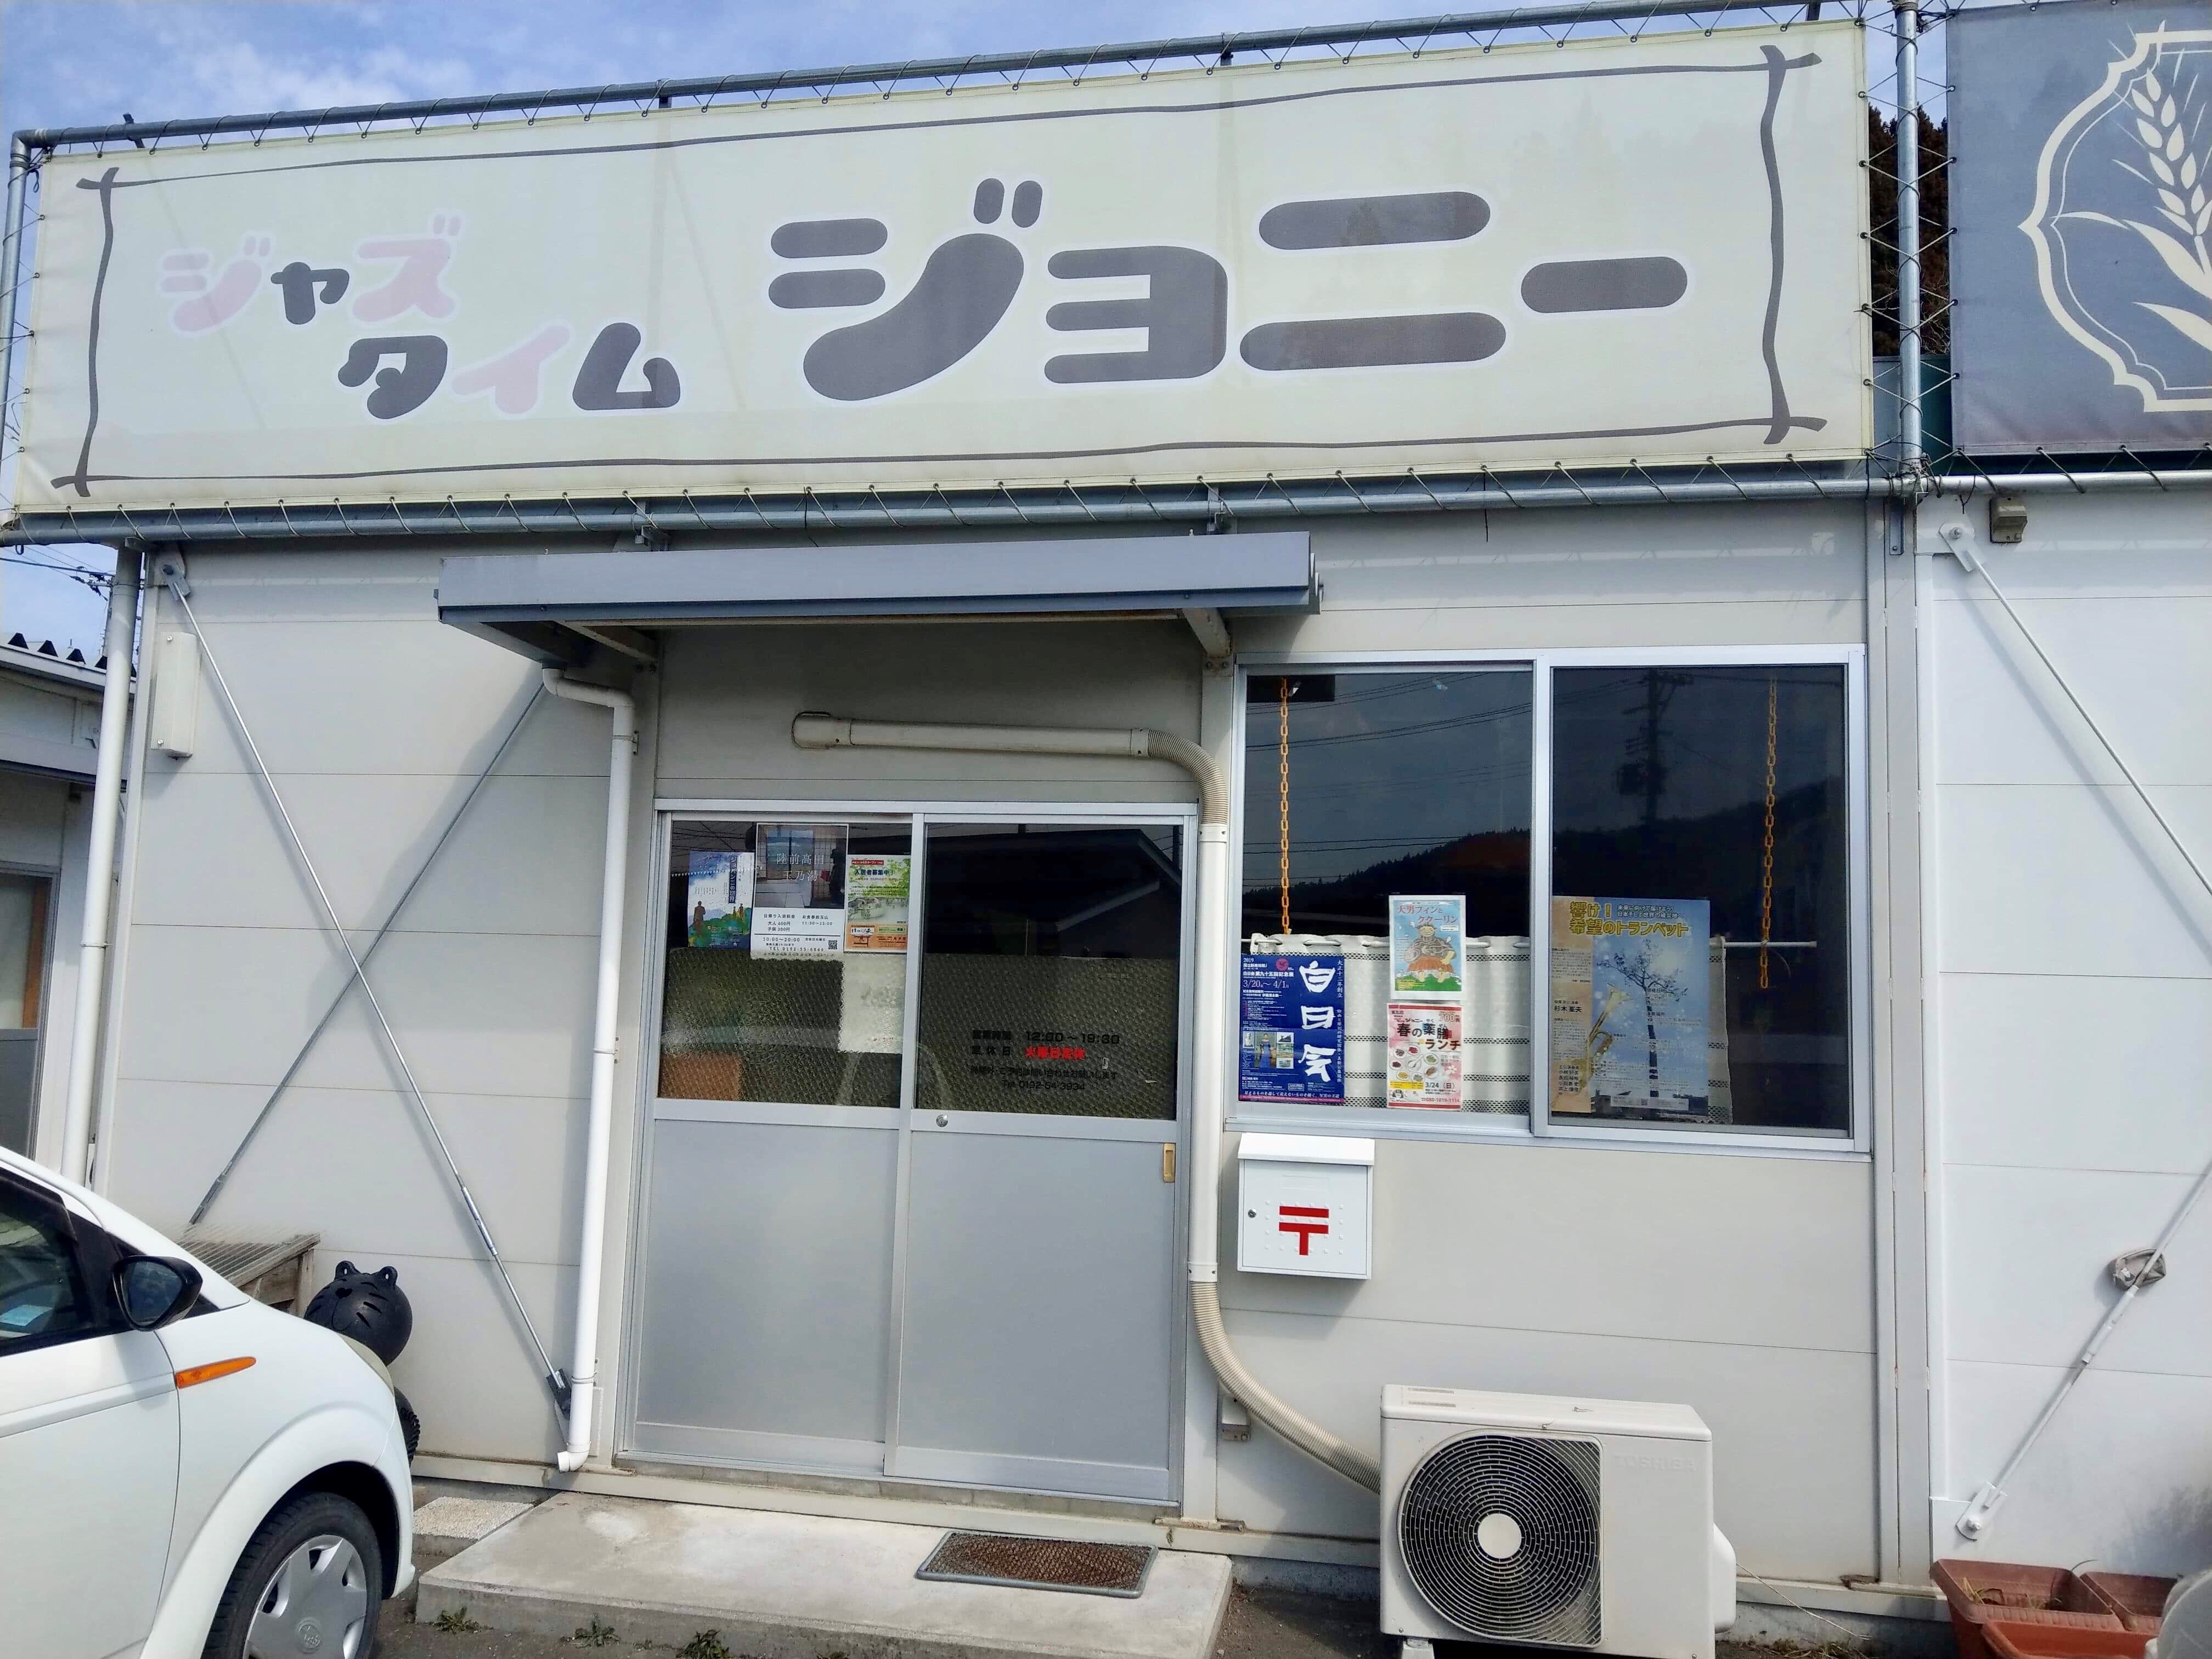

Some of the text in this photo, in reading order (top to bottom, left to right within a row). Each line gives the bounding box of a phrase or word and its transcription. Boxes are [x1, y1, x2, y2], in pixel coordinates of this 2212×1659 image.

[160, 215, 455, 331] ジャズ
[768, 178, 1688, 401] ジョニー
[337, 323, 681, 420] タイム
[1569, 918, 1690, 938] 希望のトランペット
[1570, 901, 1612, 918] 響け！
[1297, 960, 1336, 1082] 白日会
[1425, 1039, 1461, 1051] ランチ
[1614, 1454, 1697, 1473] TOSHIBA
